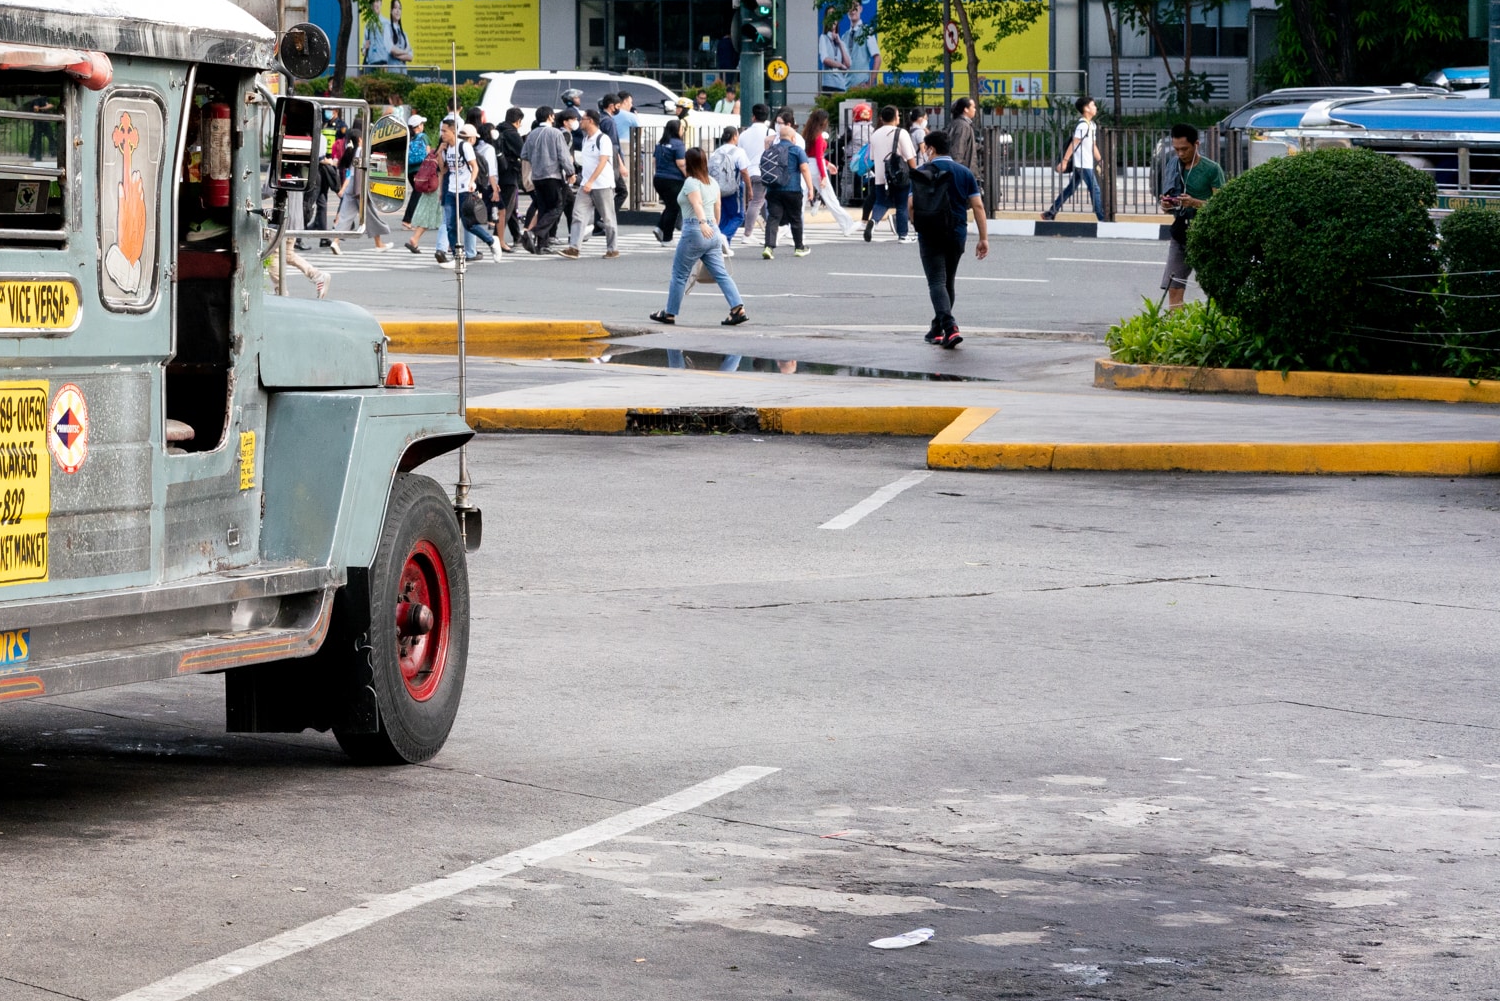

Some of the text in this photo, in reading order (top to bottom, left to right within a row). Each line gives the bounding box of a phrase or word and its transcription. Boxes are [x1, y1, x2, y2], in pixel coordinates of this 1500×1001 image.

[984, 79, 1006, 96] STI
[8, 285, 31, 324] VICE
[33, 285, 65, 324] VERSA
[14, 531, 47, 569] MARKET
